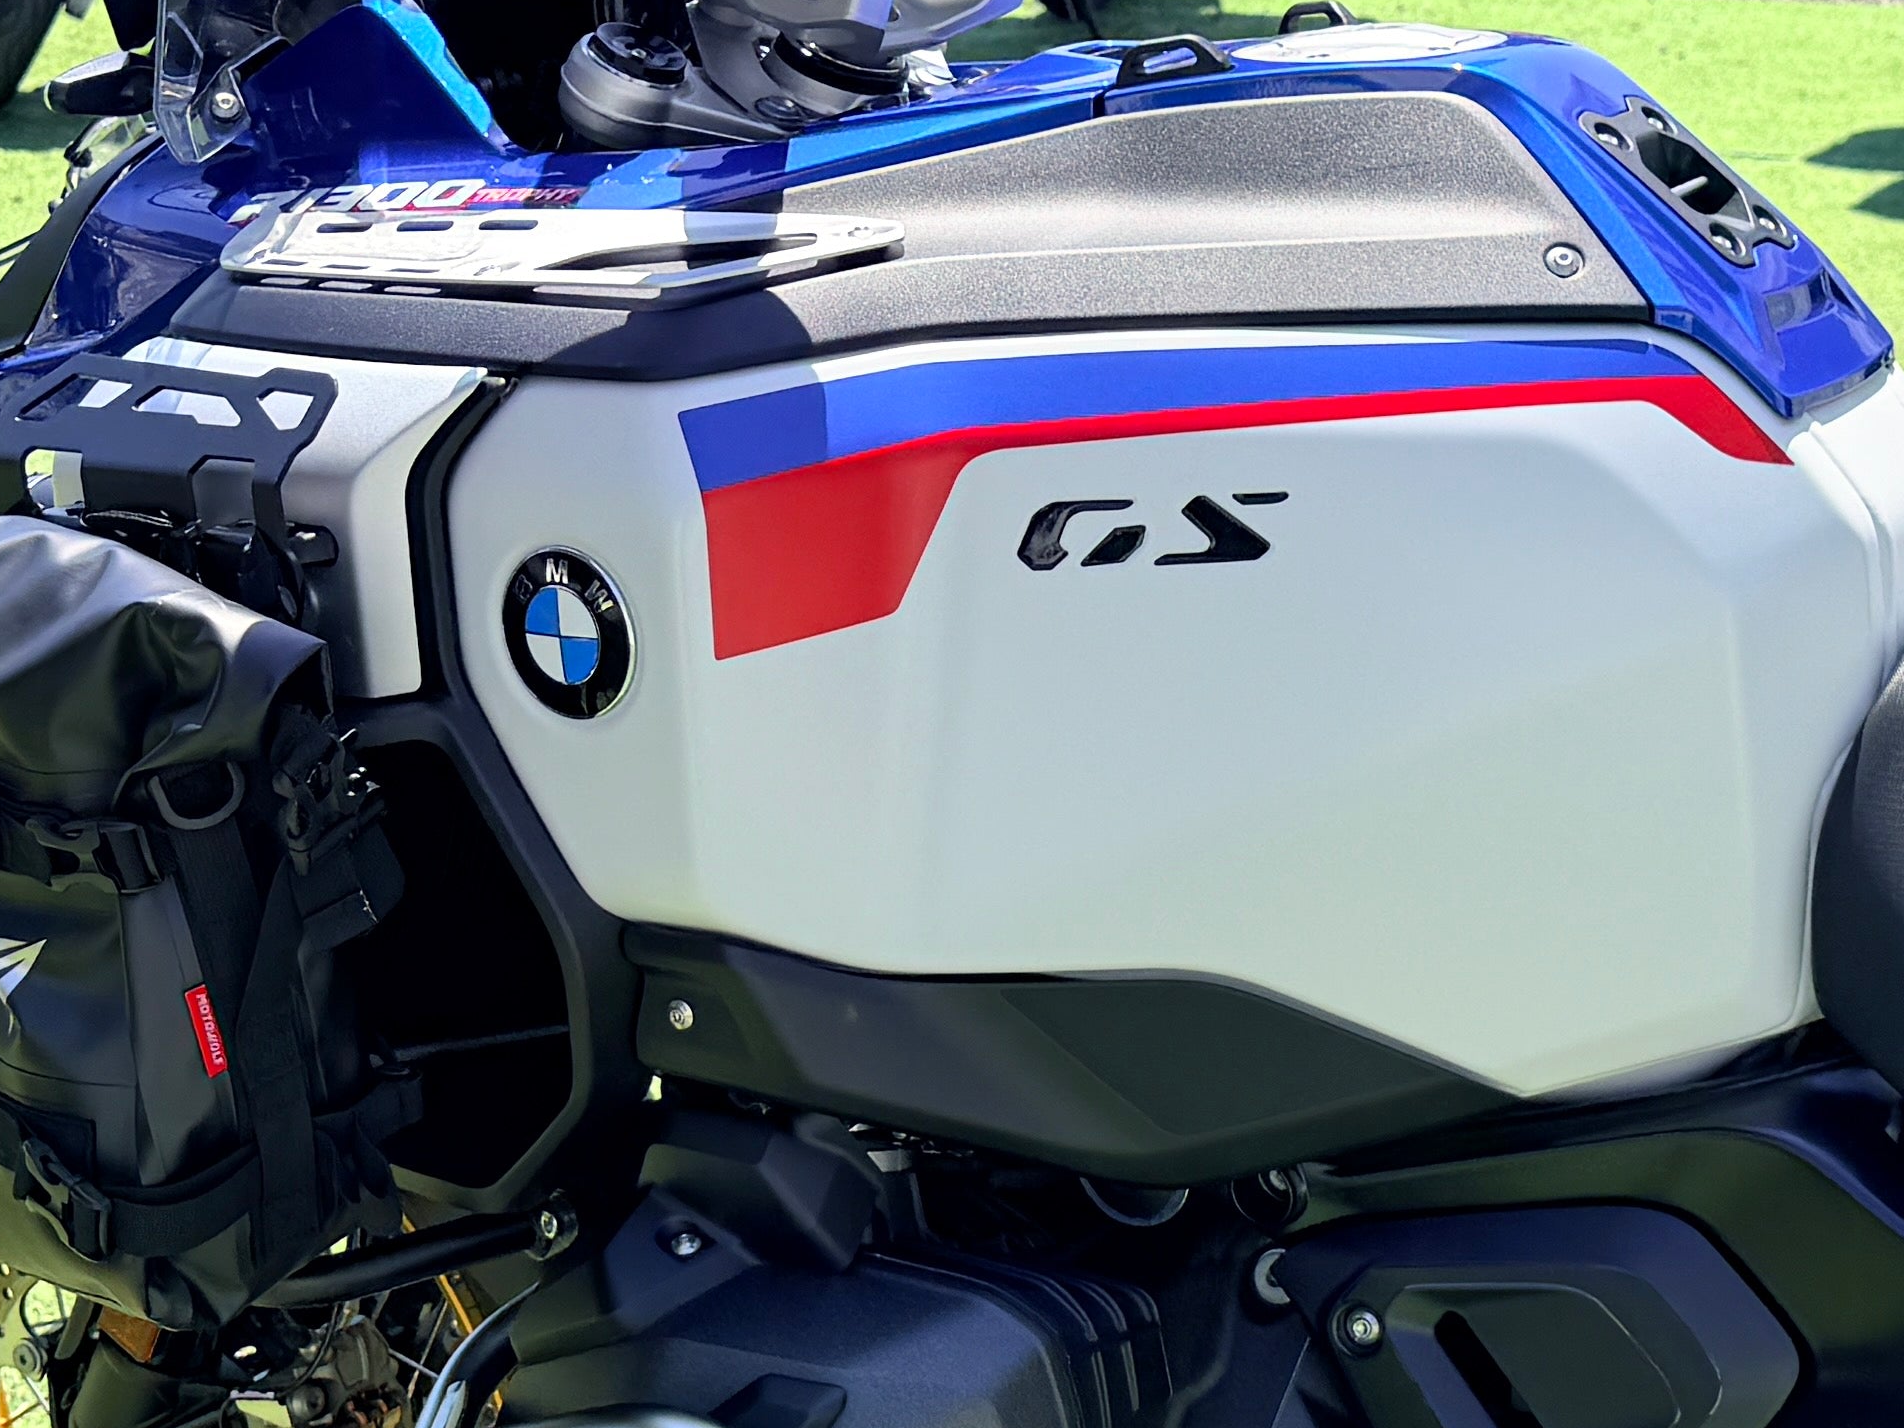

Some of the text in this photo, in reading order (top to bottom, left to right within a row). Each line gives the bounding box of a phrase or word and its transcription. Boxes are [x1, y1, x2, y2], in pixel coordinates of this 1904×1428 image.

[473, 186, 583, 204] TROPHY
[1016, 491, 1290, 571] GS
[514, 557, 615, 614] BMW
